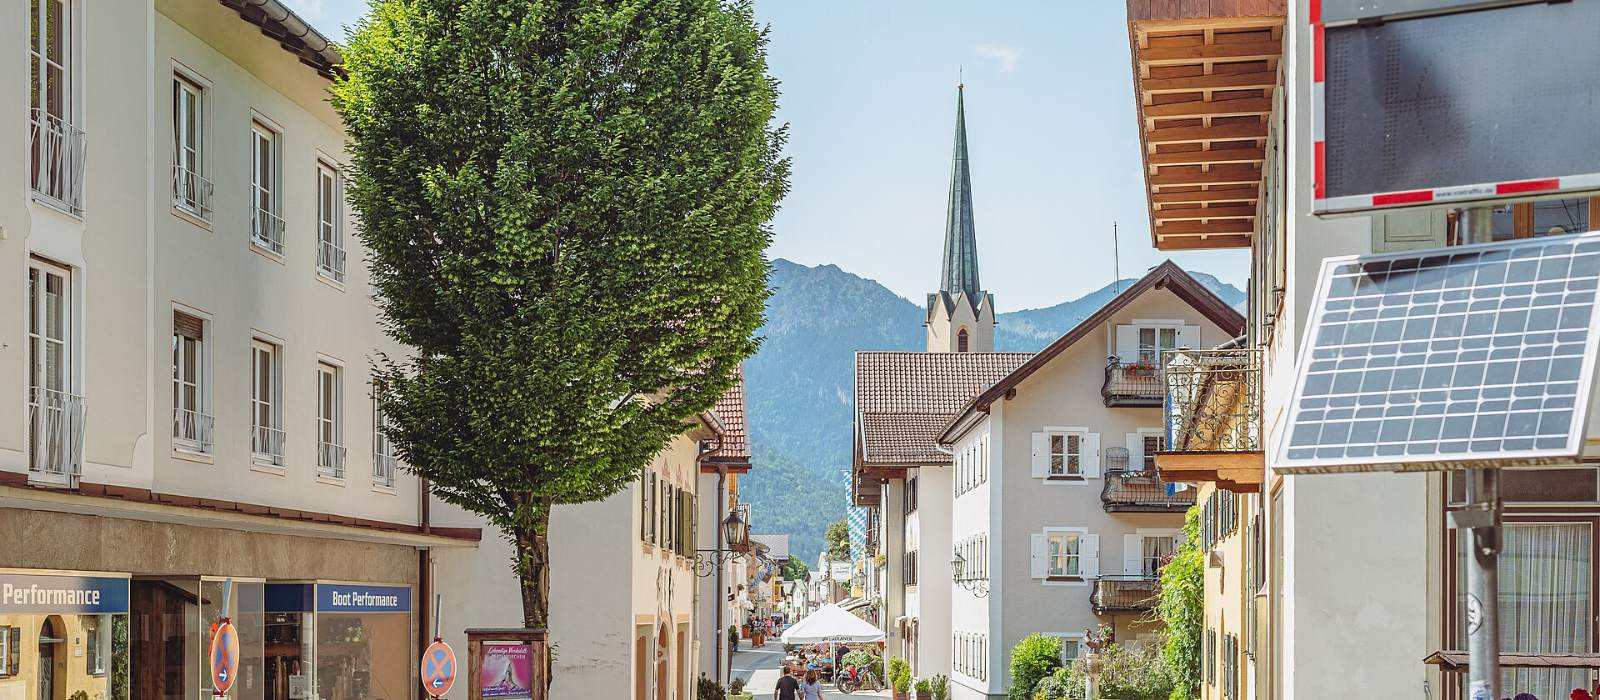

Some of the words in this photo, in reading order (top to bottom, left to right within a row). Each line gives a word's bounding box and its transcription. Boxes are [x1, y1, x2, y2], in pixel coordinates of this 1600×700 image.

[3, 583, 100, 605] Performance
[332, 591, 351, 606] Boot
[352, 592, 398, 607] Performance
